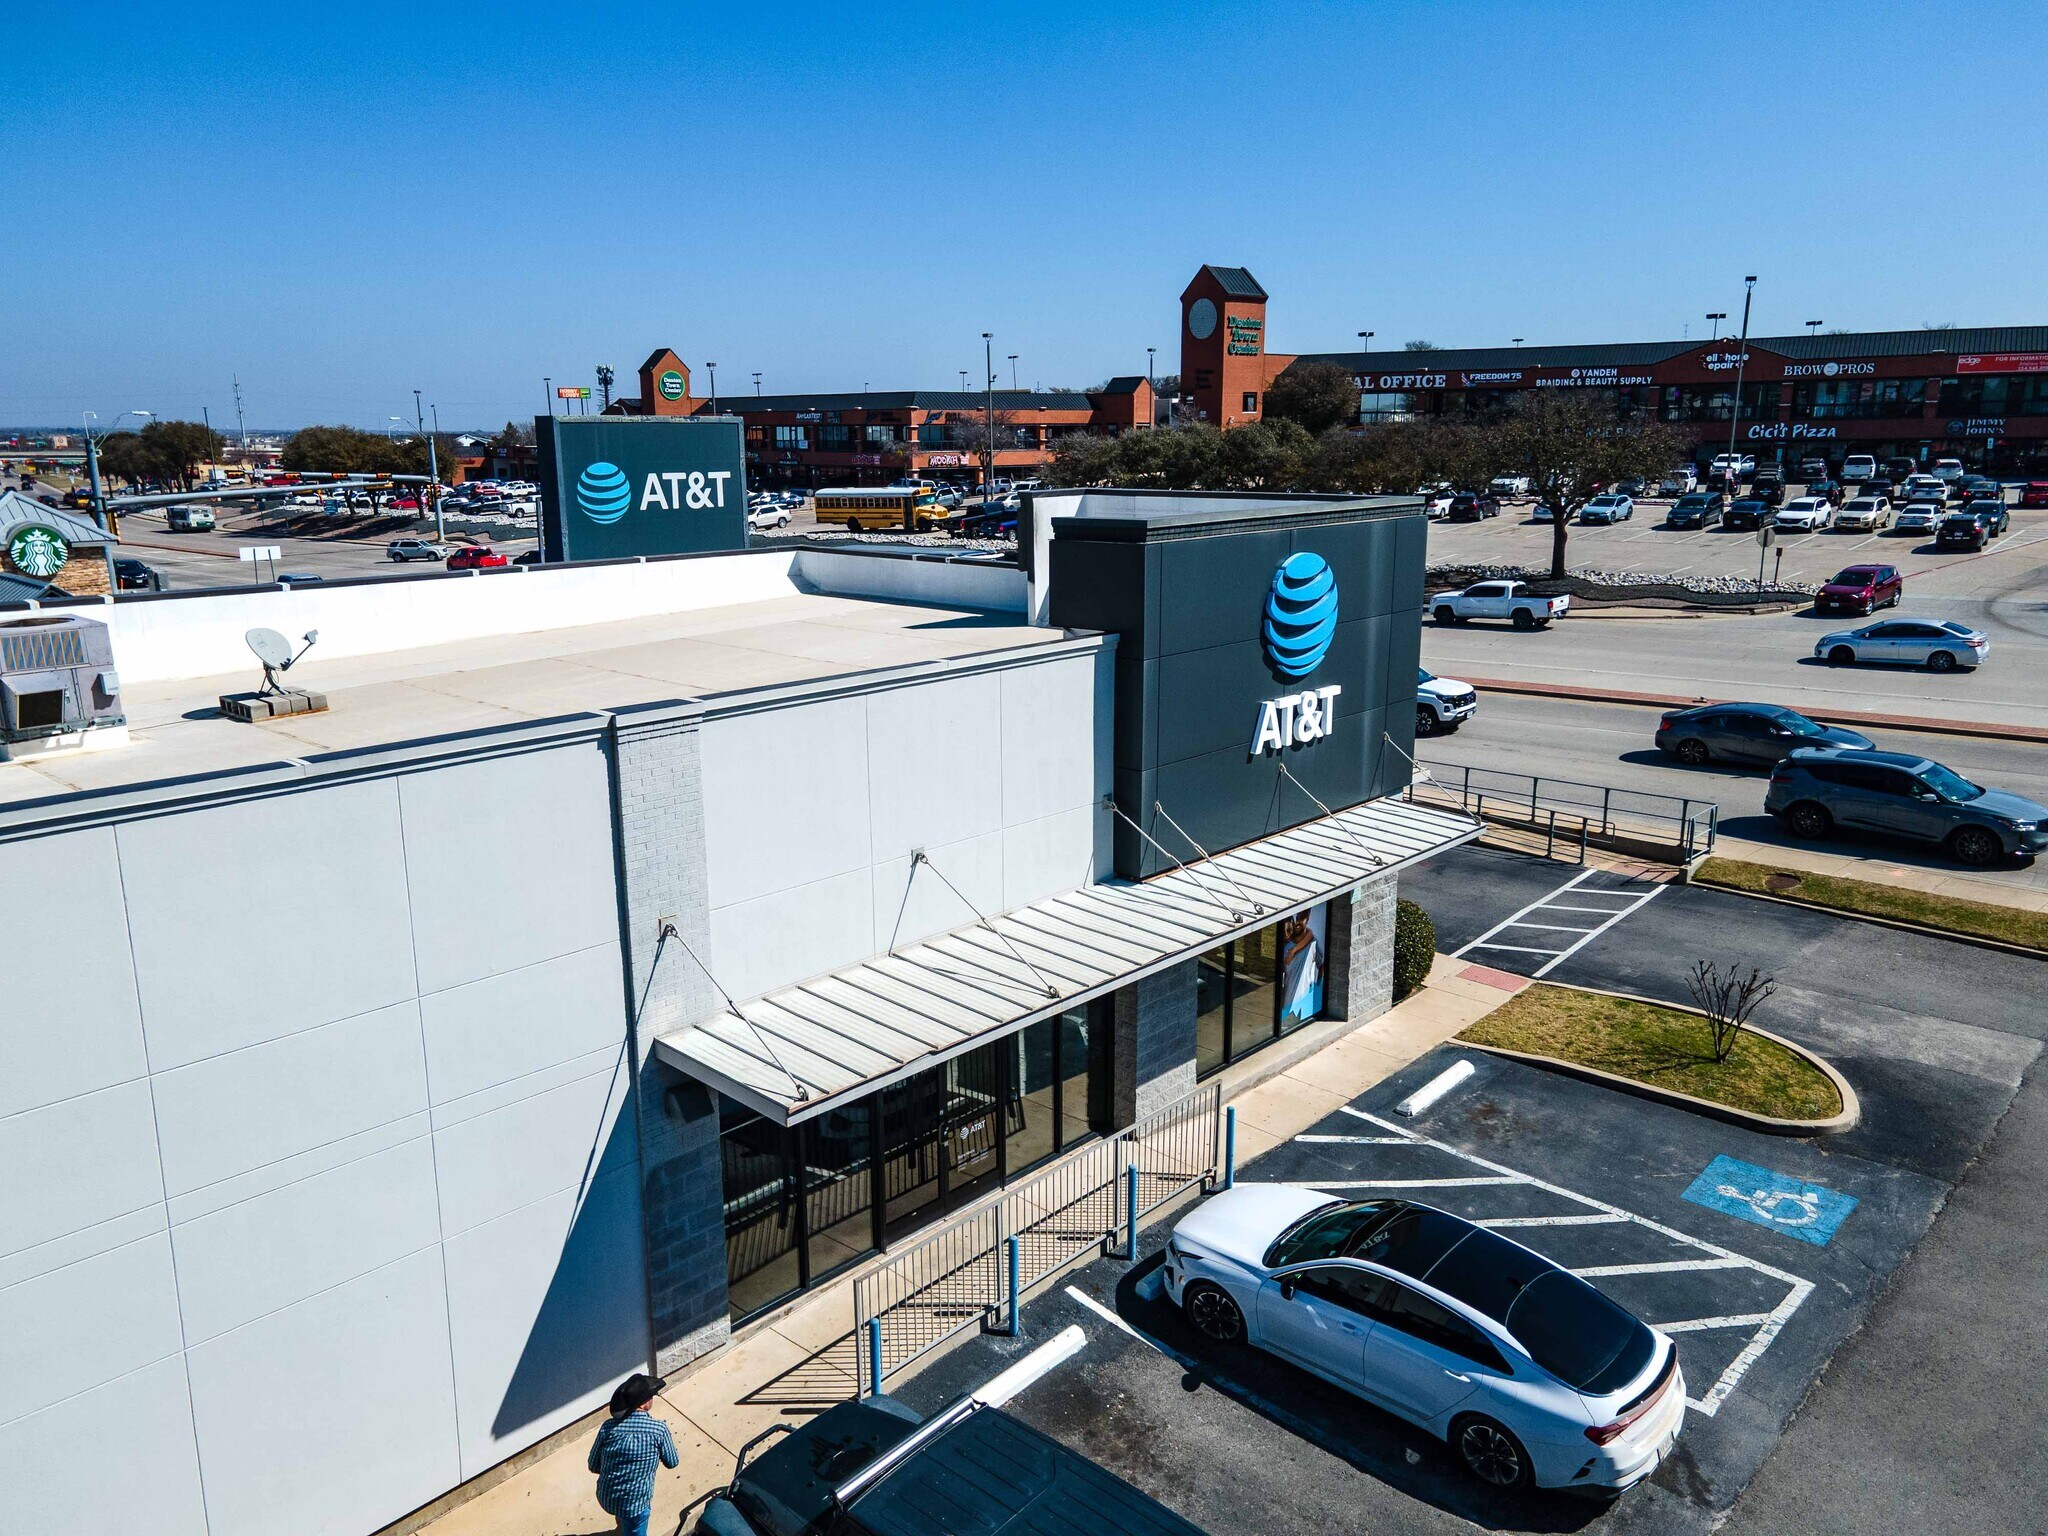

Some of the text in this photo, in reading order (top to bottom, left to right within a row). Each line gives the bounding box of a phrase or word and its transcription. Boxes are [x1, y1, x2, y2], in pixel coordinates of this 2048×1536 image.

[1582, 368, 1618, 377] YANDEH
[1703, 360, 1734, 371] epair
[1783, 362, 1875, 376] BROW PROS
[1380, 374, 1446, 388] OFFICE
[1536, 376, 1653, 387] BRAIDING & BEAUTY SUPPLY
[1966, 418, 2006, 427] JIMMY
[1748, 422, 1836, 438] Cici's Pizza
[1966, 427, 2005, 436] JOHN'S
[640, 471, 731, 511] AT&T
[1250, 685, 1342, 756] AT&T
[970, 1119, 986, 1134] AT&T
